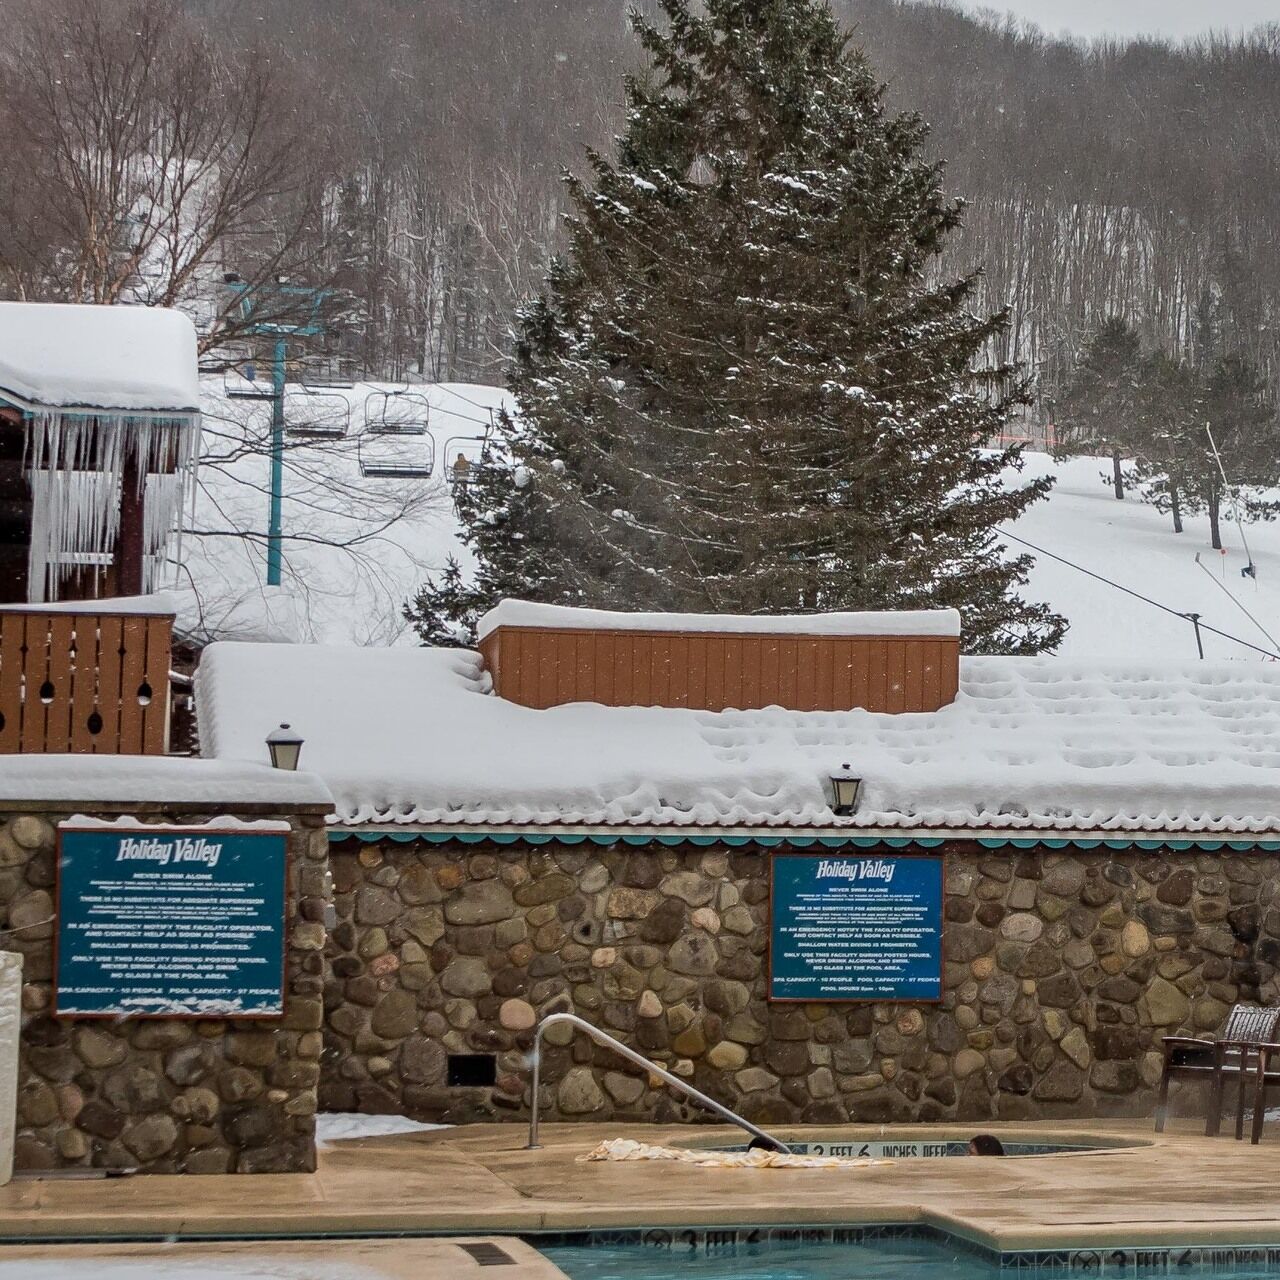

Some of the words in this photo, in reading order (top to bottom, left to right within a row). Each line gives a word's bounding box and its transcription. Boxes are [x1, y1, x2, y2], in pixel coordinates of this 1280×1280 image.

[115, 838, 173, 865] Holiday
[173, 838, 222, 867] Valley
[816, 860, 857, 881] Holiday
[859, 860, 895, 882] Valley
